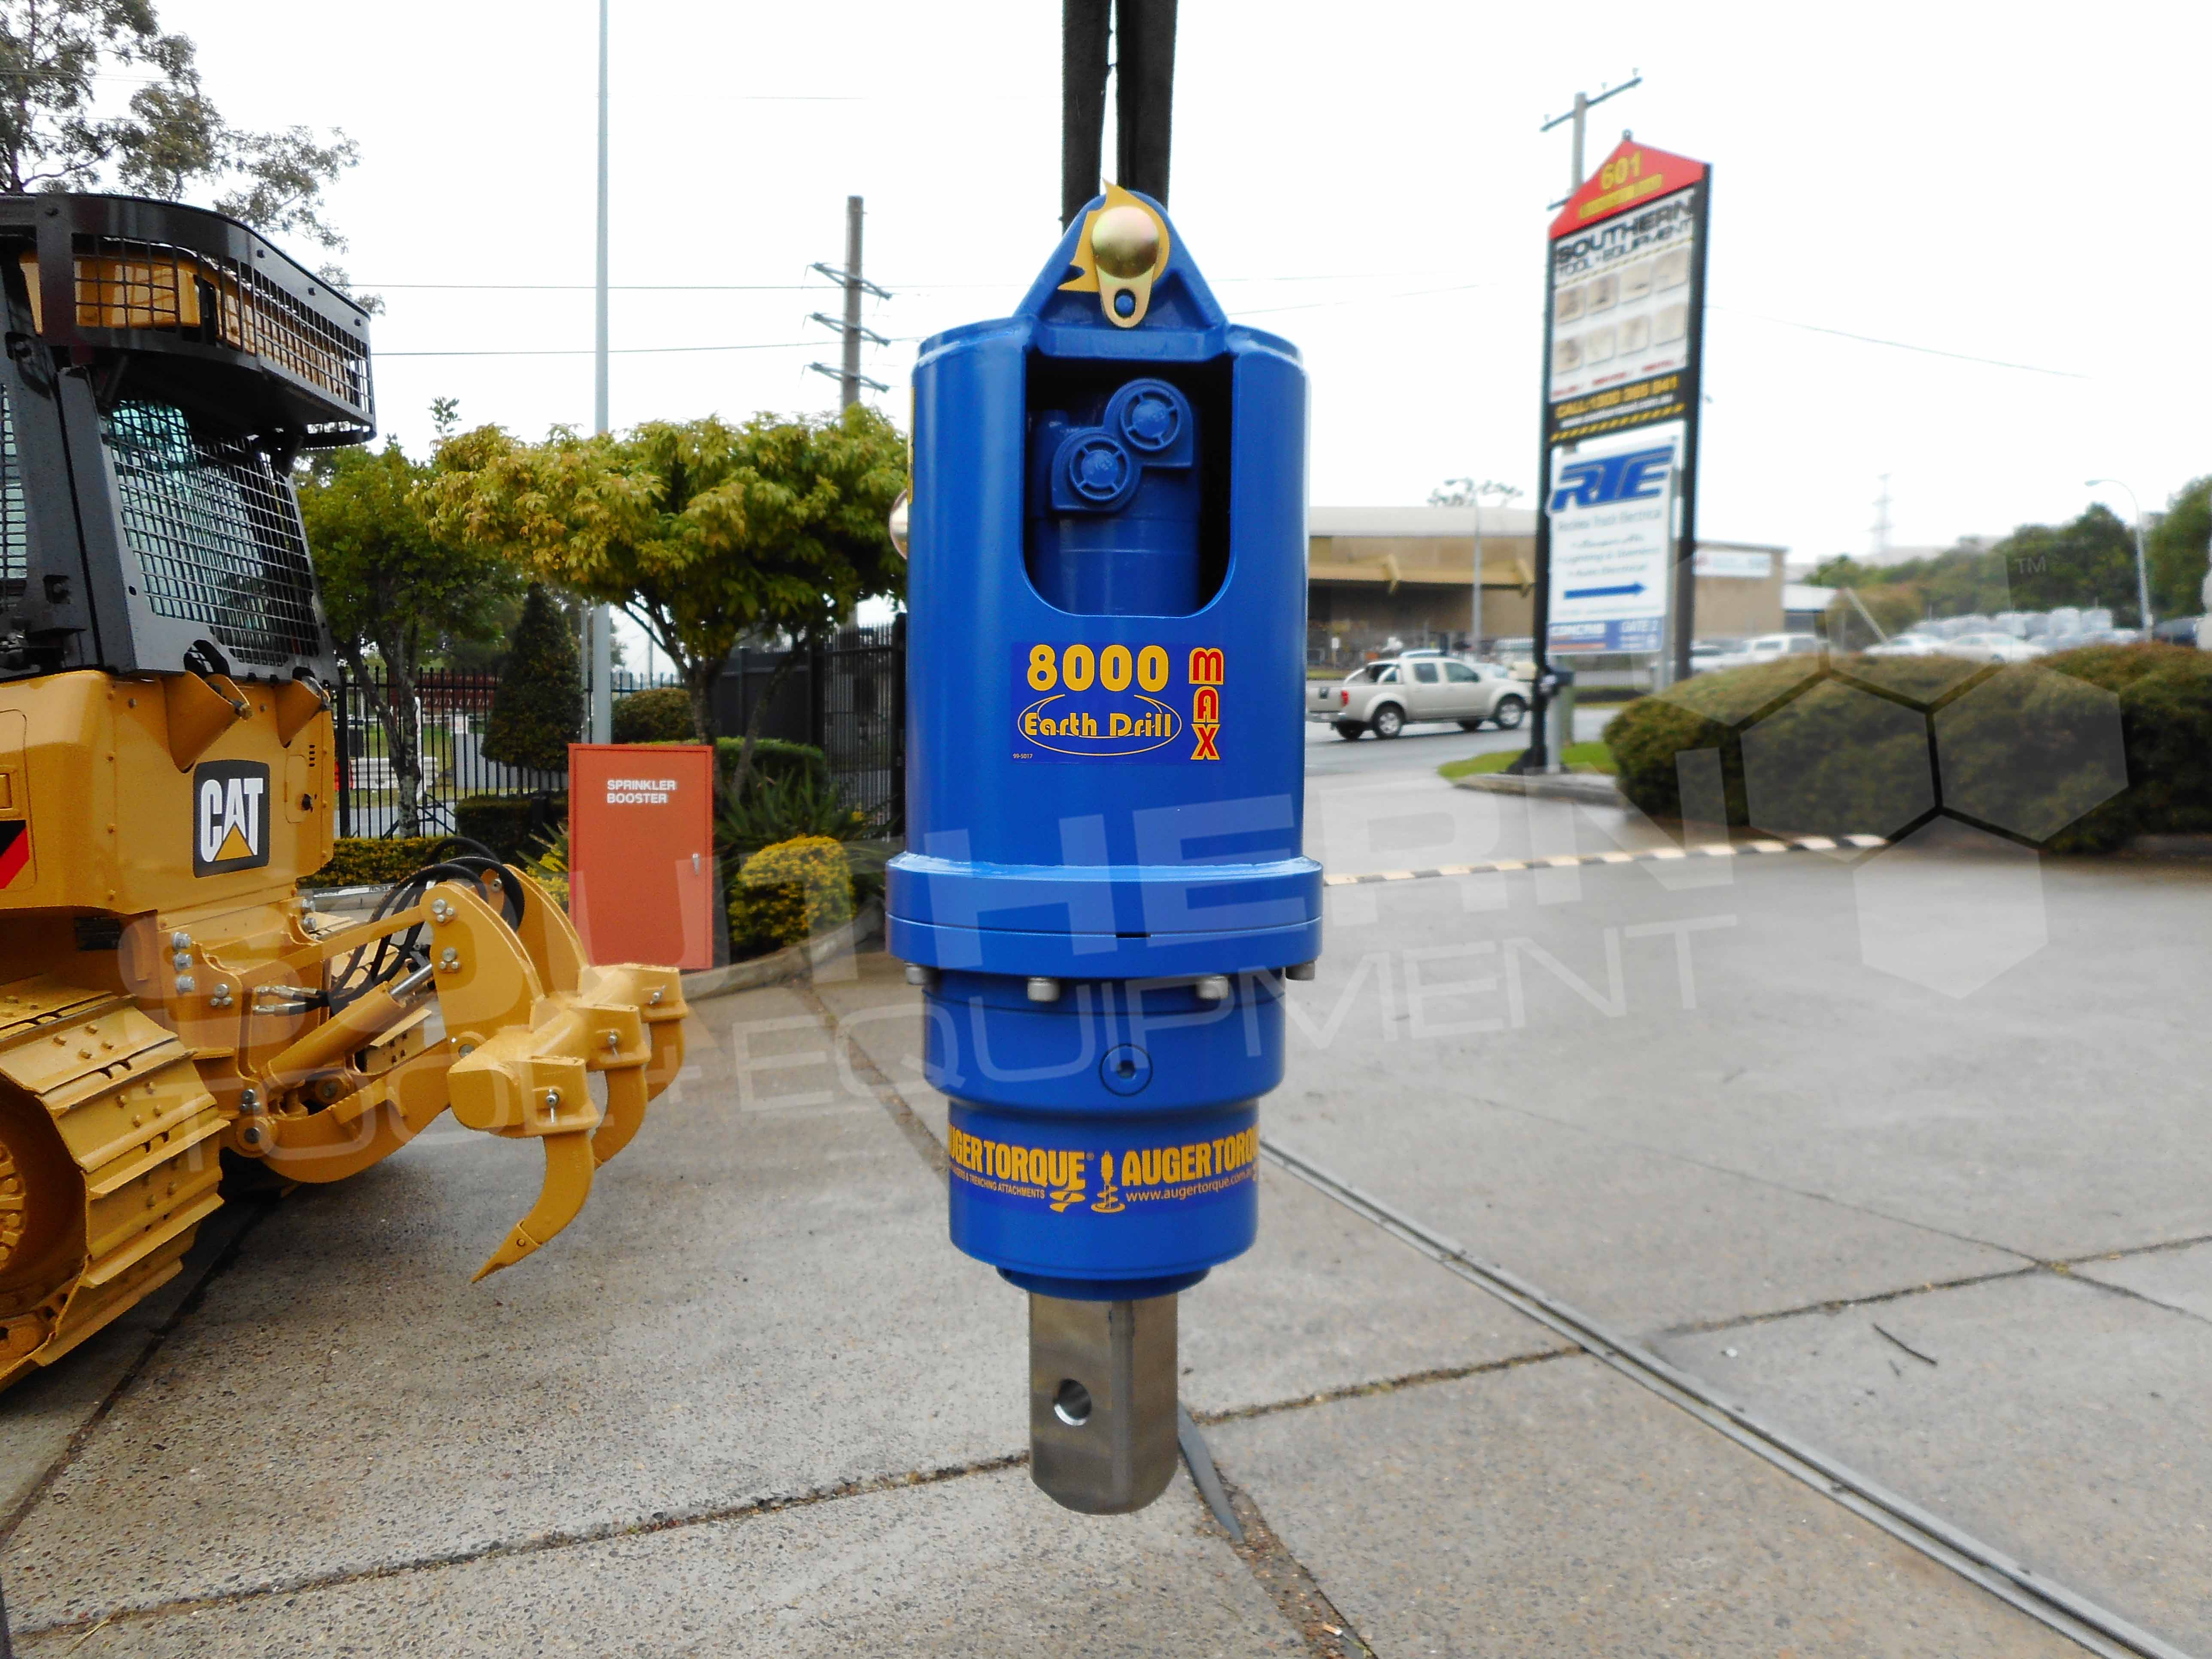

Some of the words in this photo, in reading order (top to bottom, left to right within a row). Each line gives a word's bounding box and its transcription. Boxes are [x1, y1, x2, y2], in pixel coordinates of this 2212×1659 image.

[1601, 150, 1642, 190] 601
[1027, 644, 1169, 692] 8000
[1024, 712, 1097, 736] Earth
[1109, 712, 1171, 737] Drill
[607, 780, 677, 790] SPRINKLER
[607, 793, 668, 804] BOOSTER
[201, 778, 263, 862] CAT
[948, 1122, 1086, 1191] UGERTORQUE
[998, 1184, 1045, 1199] ATTACHMENTS
